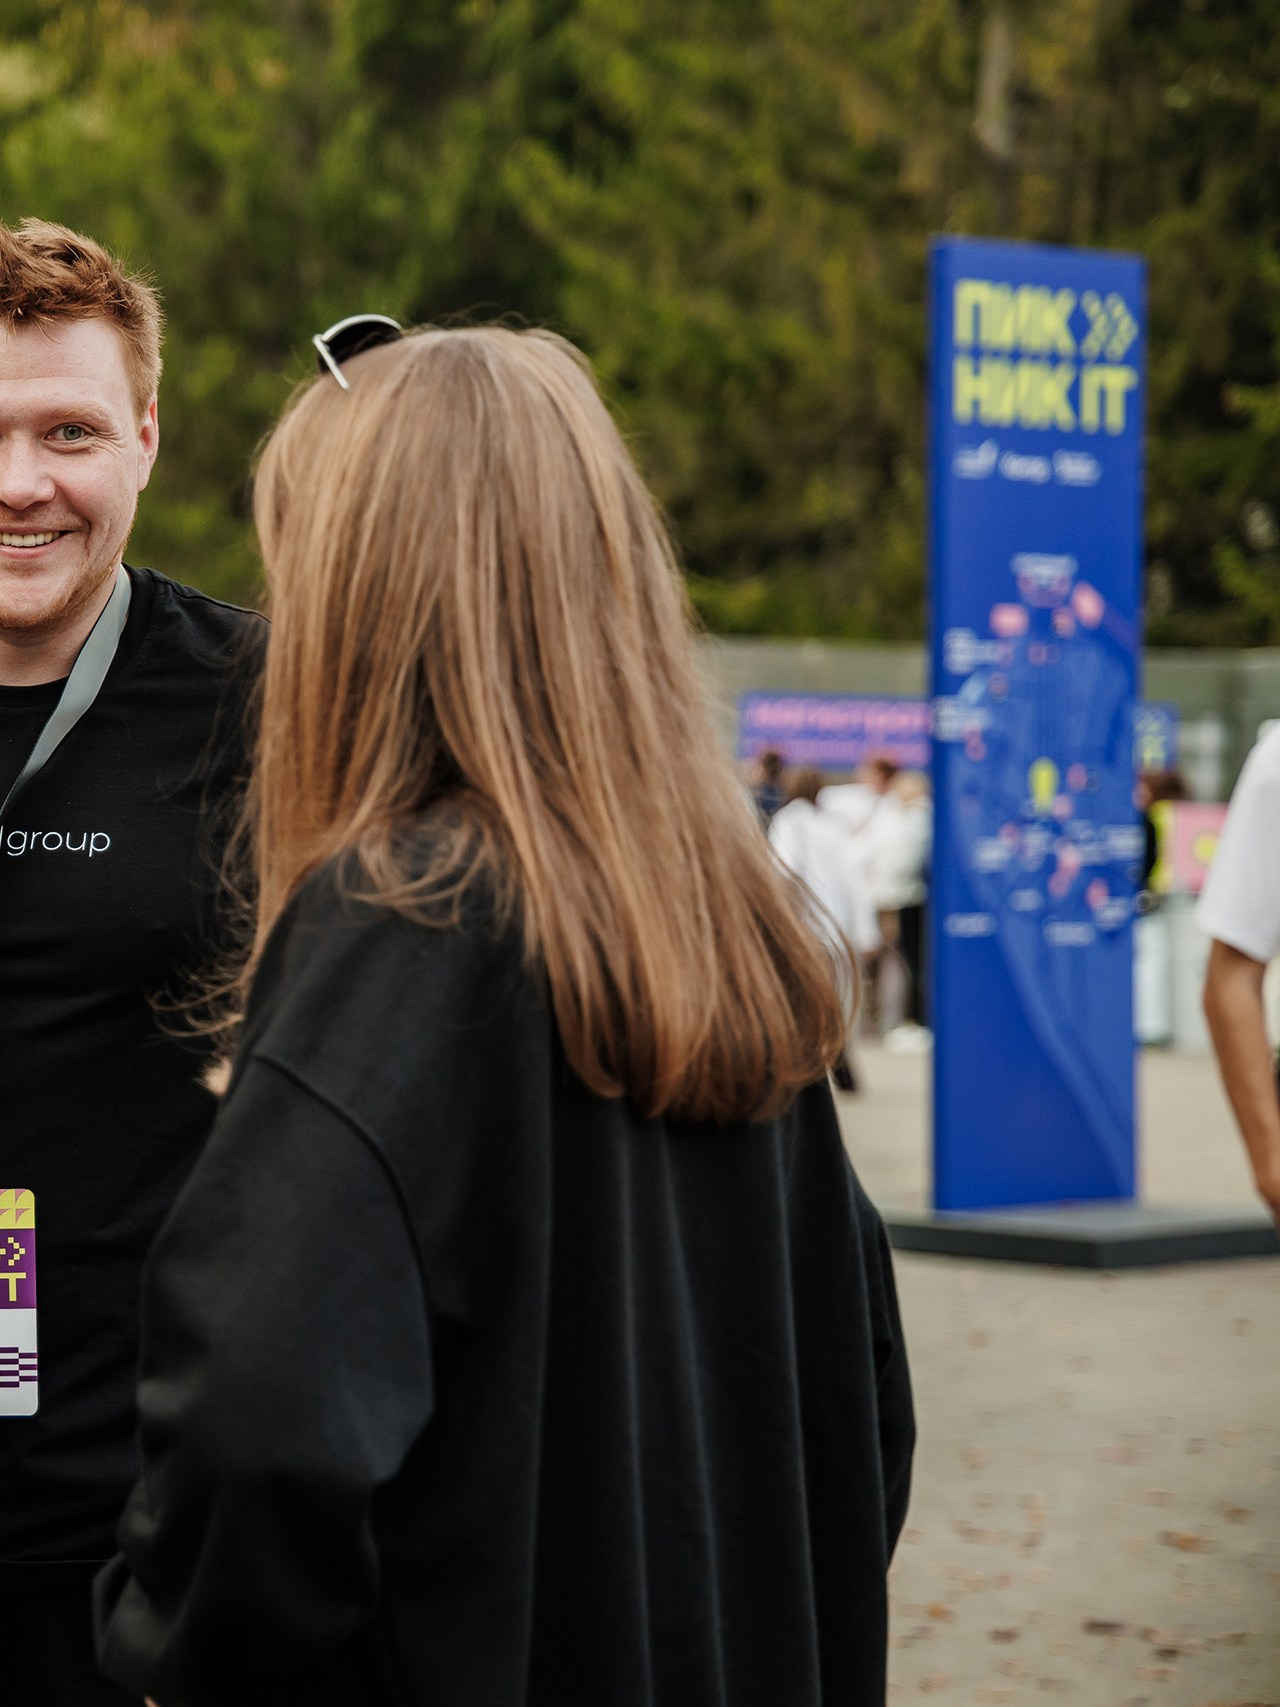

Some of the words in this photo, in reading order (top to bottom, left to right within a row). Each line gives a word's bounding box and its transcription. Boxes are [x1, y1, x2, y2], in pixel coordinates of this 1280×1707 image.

[954, 279, 1076, 357] ПИК
[953, 354, 1076, 432] НИК
[1080, 365, 1137, 434] IT
